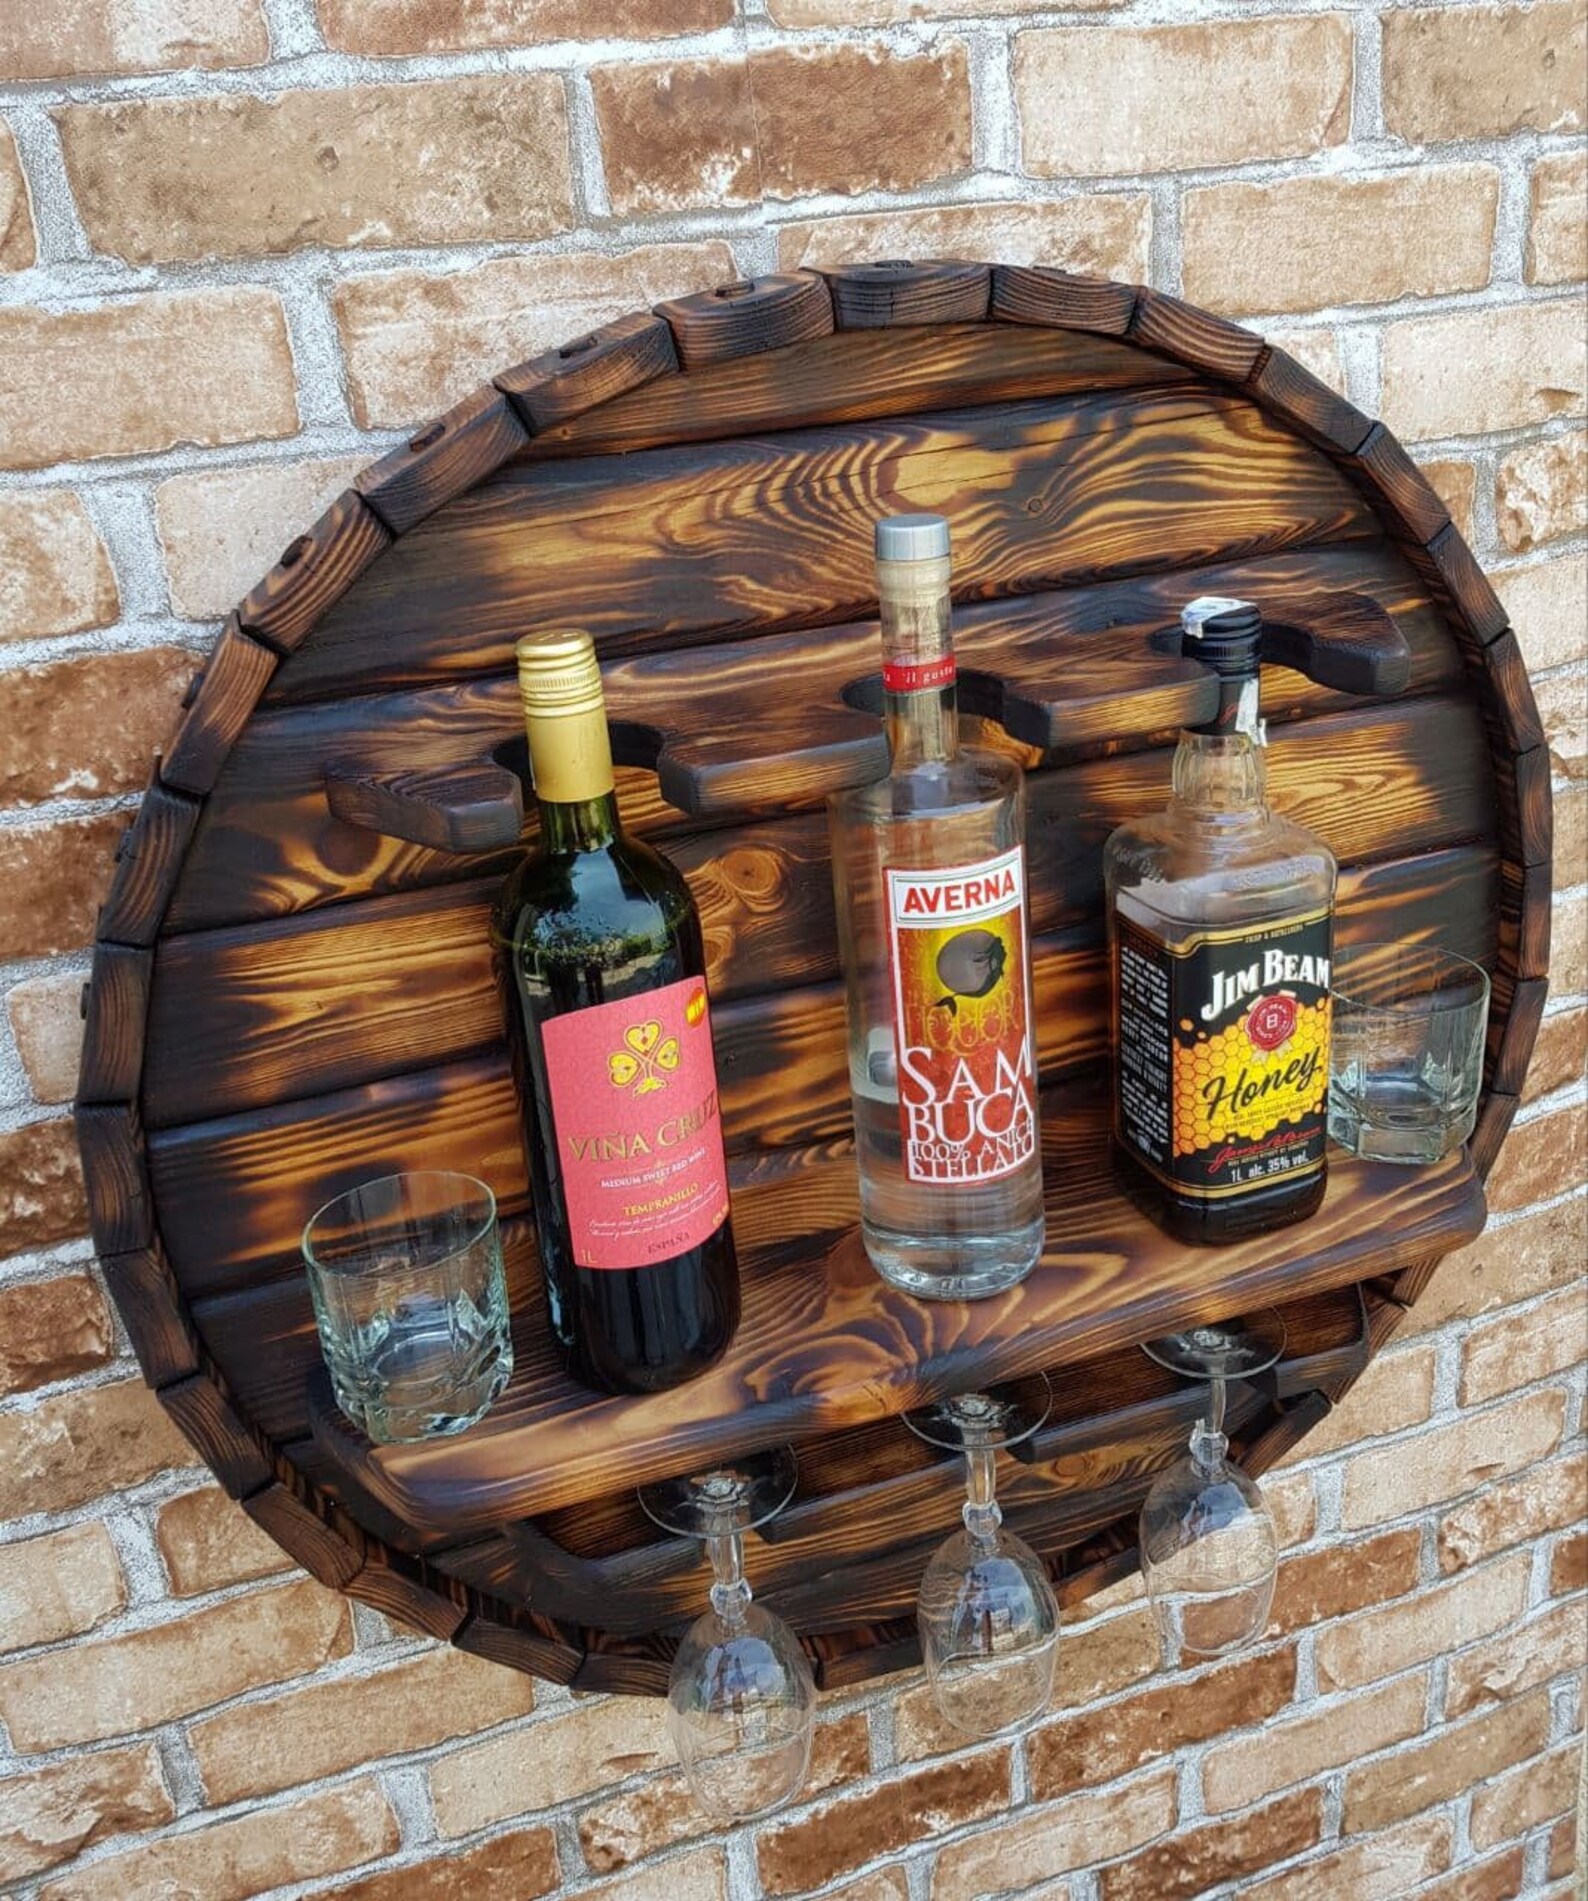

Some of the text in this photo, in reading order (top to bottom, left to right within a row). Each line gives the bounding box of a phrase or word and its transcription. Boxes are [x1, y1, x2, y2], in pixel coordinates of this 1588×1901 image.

[903, 869, 1016, 914] AVERNA
[1201, 963, 1260, 1021] JIM
[1262, 949, 1330, 989] BEAM
[901, 1034, 1032, 1107] SAM
[1201, 1047, 1323, 1121] Honey
[568, 1089, 717, 1162] VIÑA CRUZ
[908, 1079, 1034, 1145] BUCA
[601, 1176, 641, 1189] MEDIUM
[643, 1167, 671, 1182] SWEET
[1268, 1156, 1291, 1173] 35%
[622, 1182, 699, 1216] TEMPRANILLO
